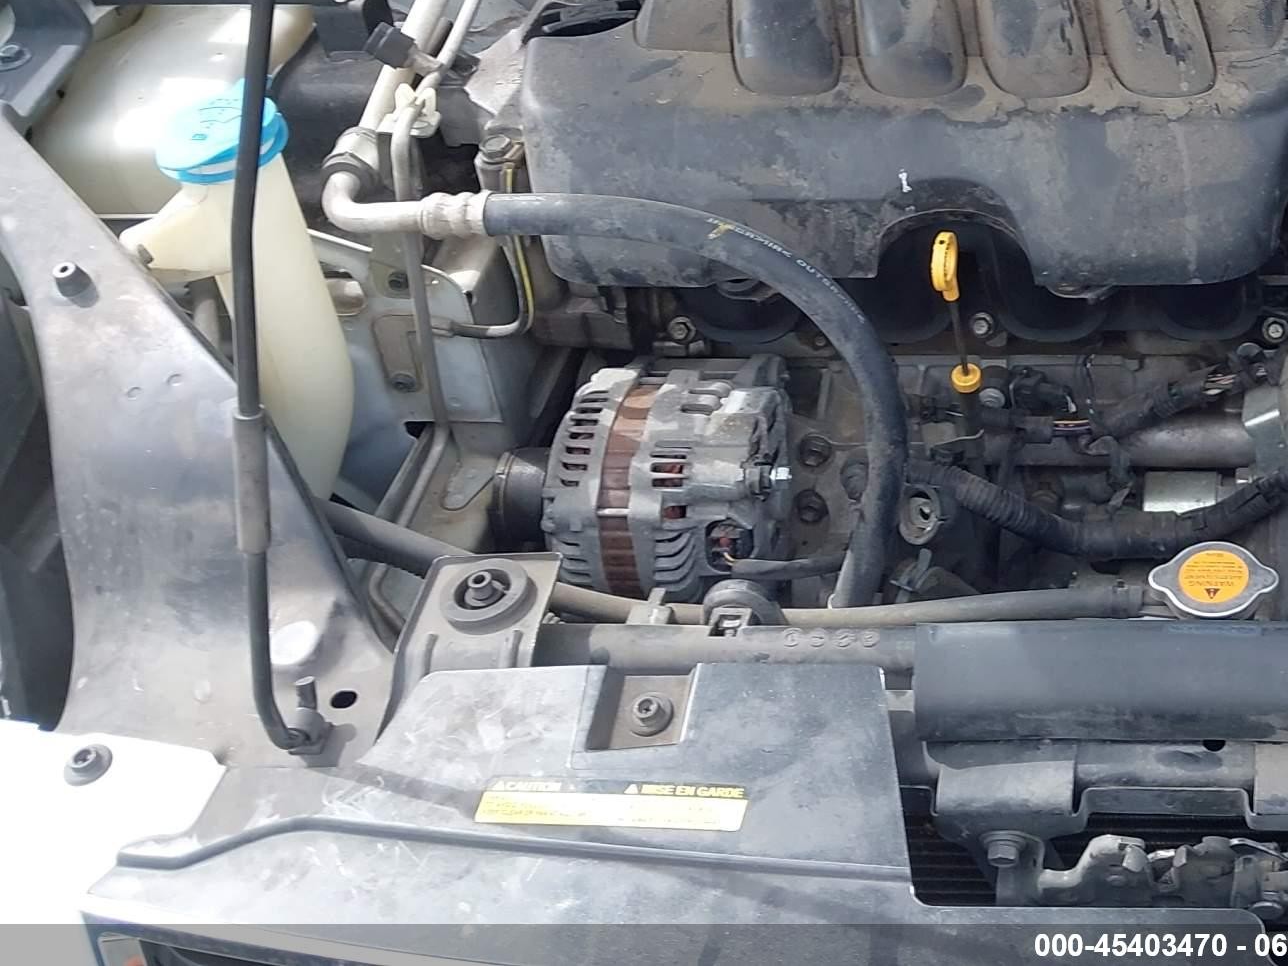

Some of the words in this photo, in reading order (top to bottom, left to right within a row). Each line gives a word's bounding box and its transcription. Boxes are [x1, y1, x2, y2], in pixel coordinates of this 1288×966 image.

[509, 781, 562, 792] CAUTION
[674, 786, 696, 797] EN
[695, 786, 745, 798] GARDE
